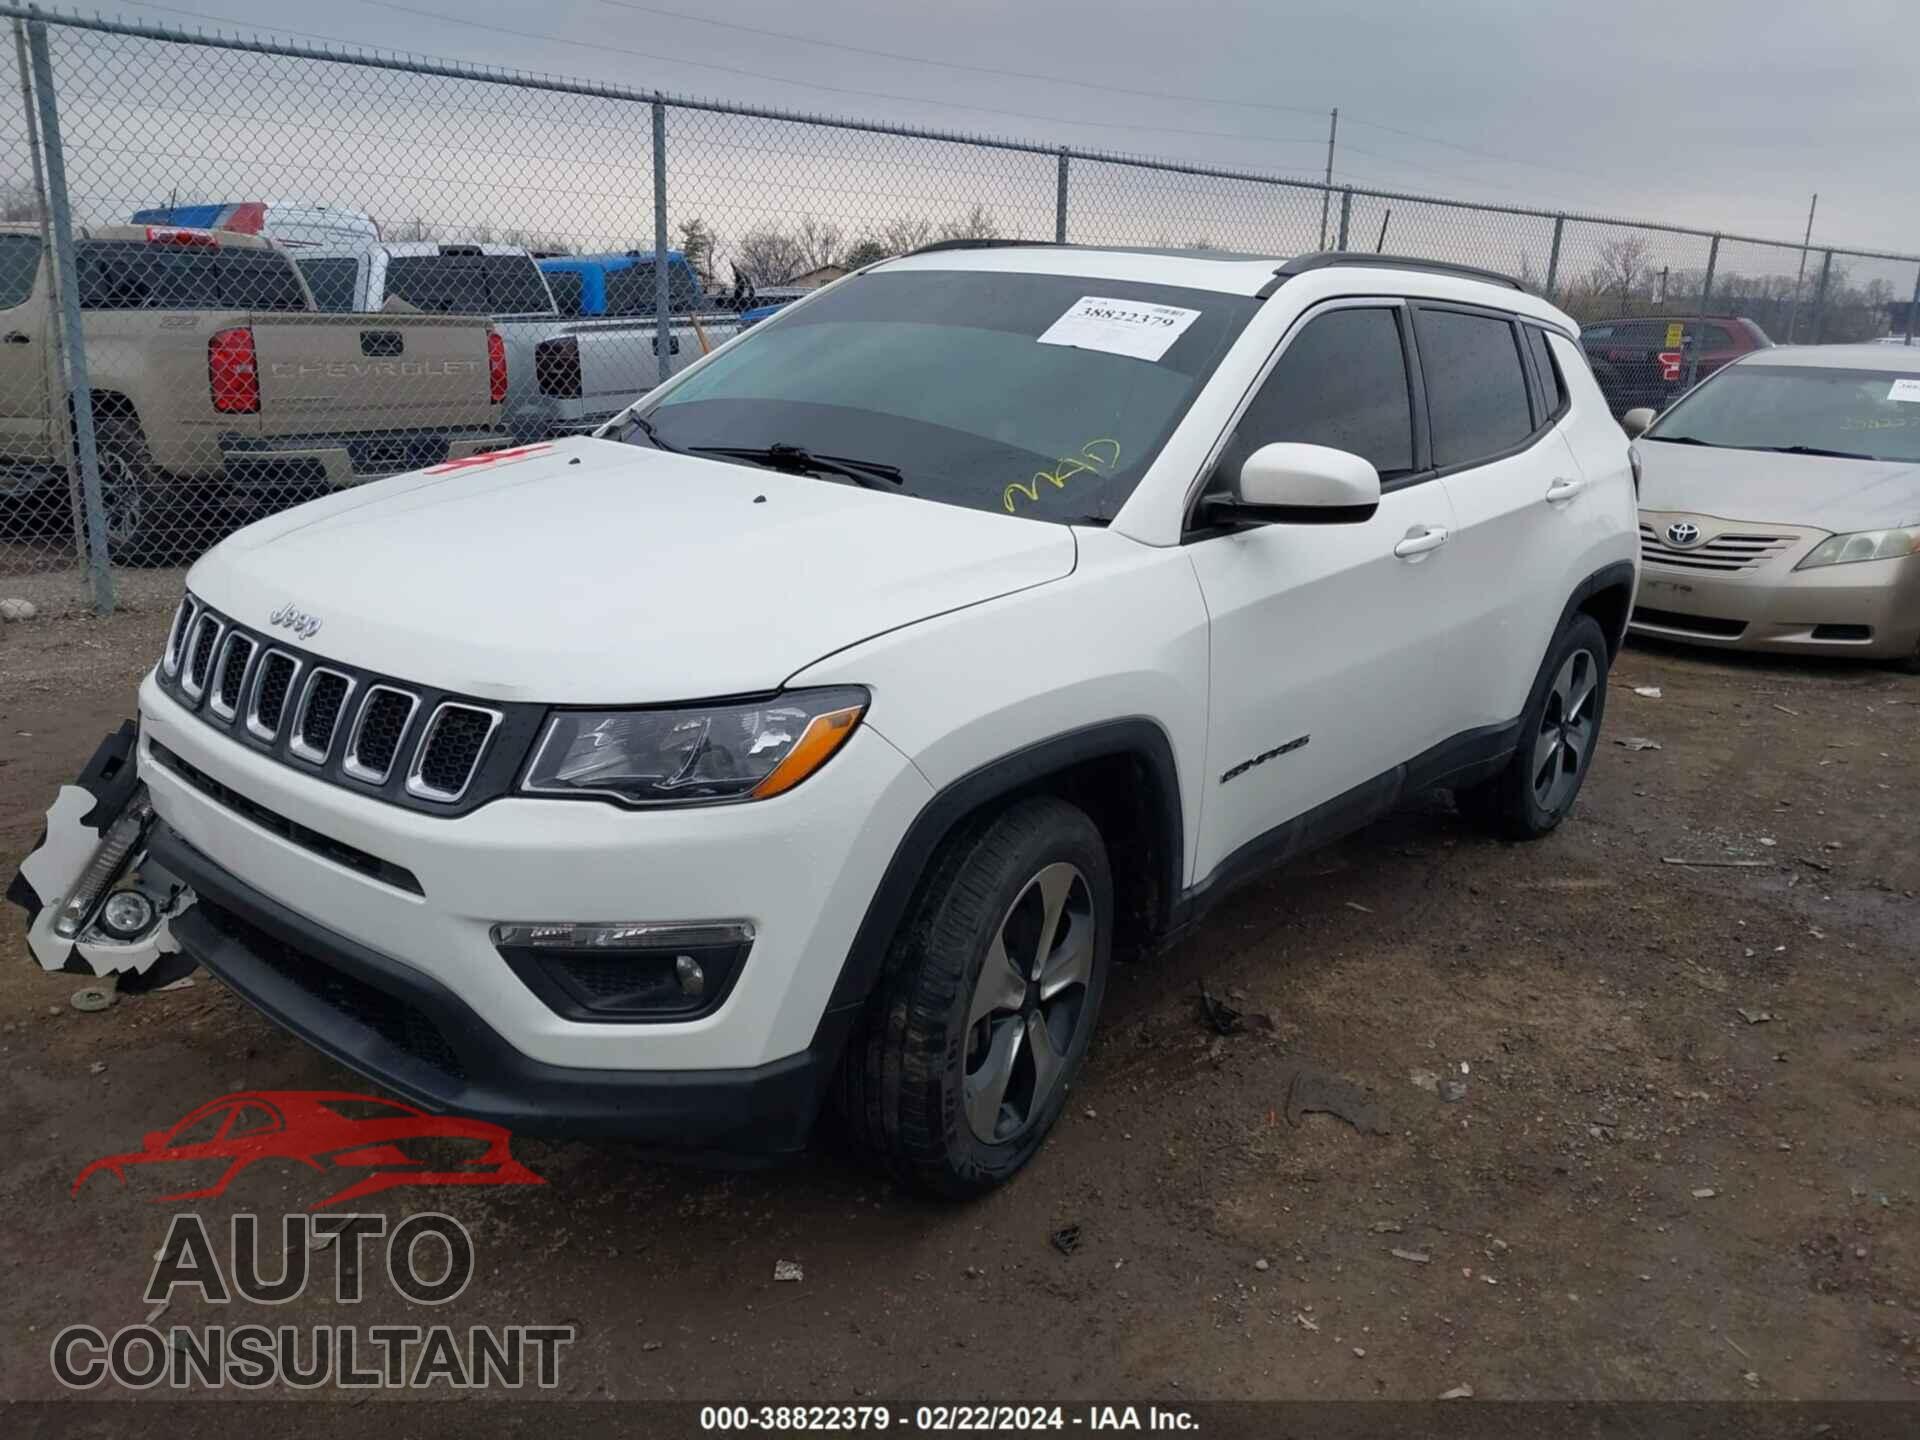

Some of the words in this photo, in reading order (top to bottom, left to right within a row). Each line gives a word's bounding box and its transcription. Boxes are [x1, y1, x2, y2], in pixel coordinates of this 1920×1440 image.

[1078, 307, 1175, 328] 38822379
[271, 359, 482, 378] CHEVROLET
[270, 600, 321, 641] Jeep
